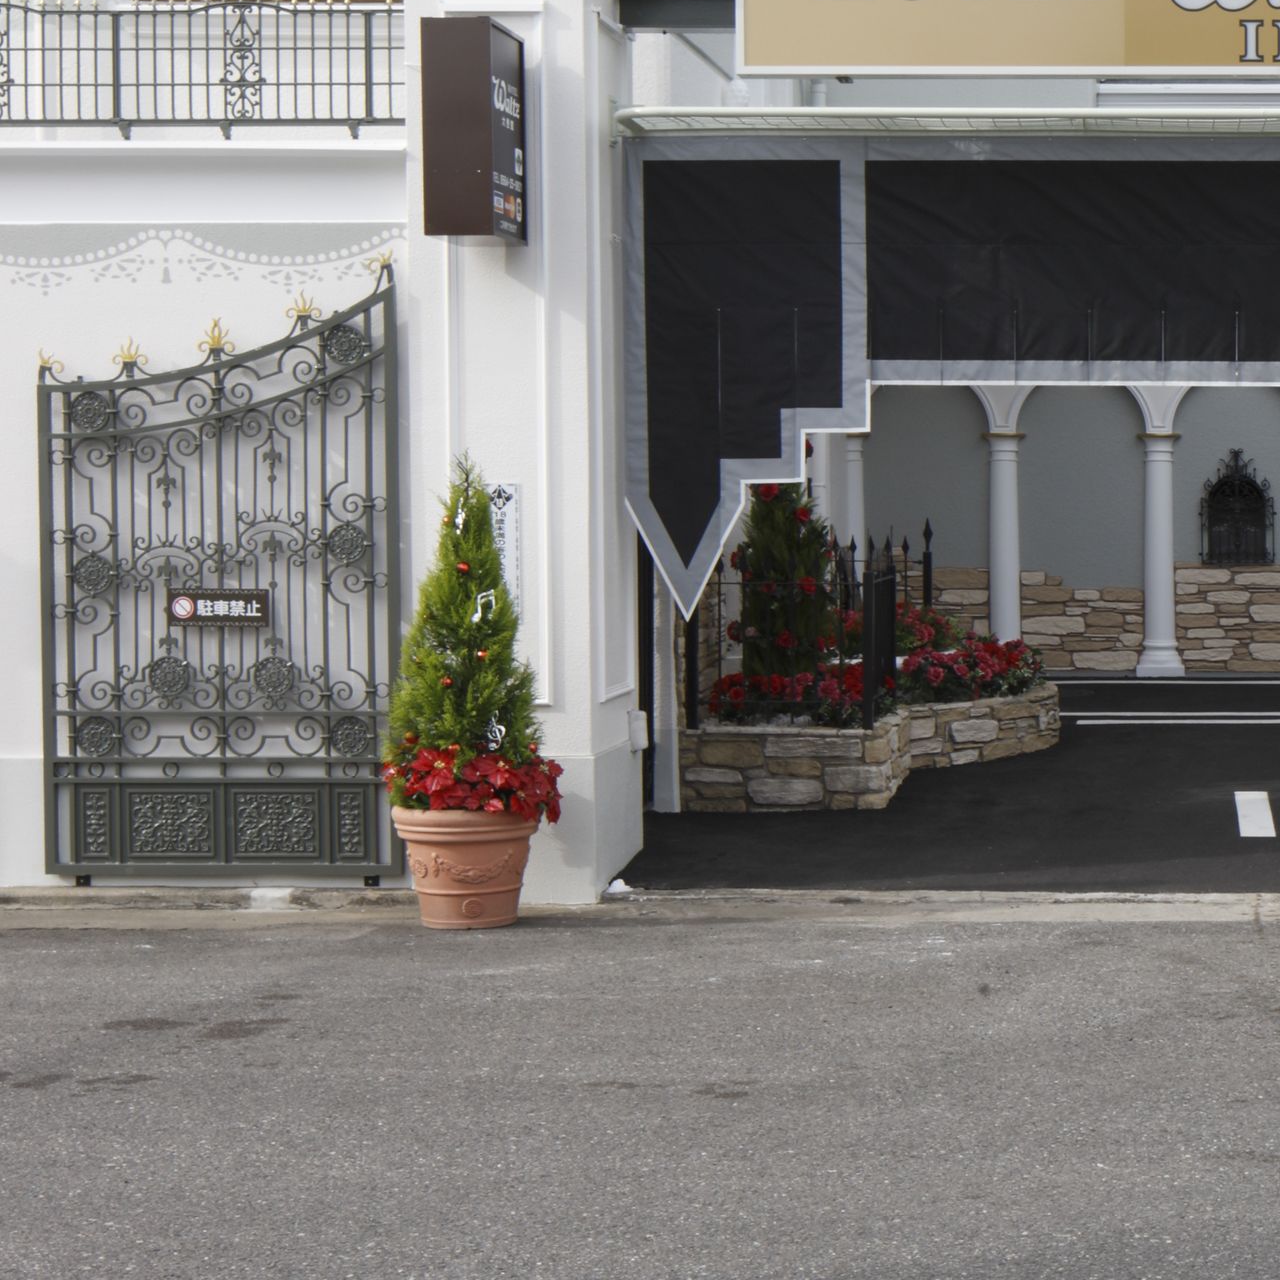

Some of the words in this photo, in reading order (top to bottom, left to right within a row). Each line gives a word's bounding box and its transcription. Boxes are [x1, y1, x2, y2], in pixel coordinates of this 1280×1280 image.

[492, 75, 520, 119] Waltz
[196, 599, 262, 617] 駐車禁止
